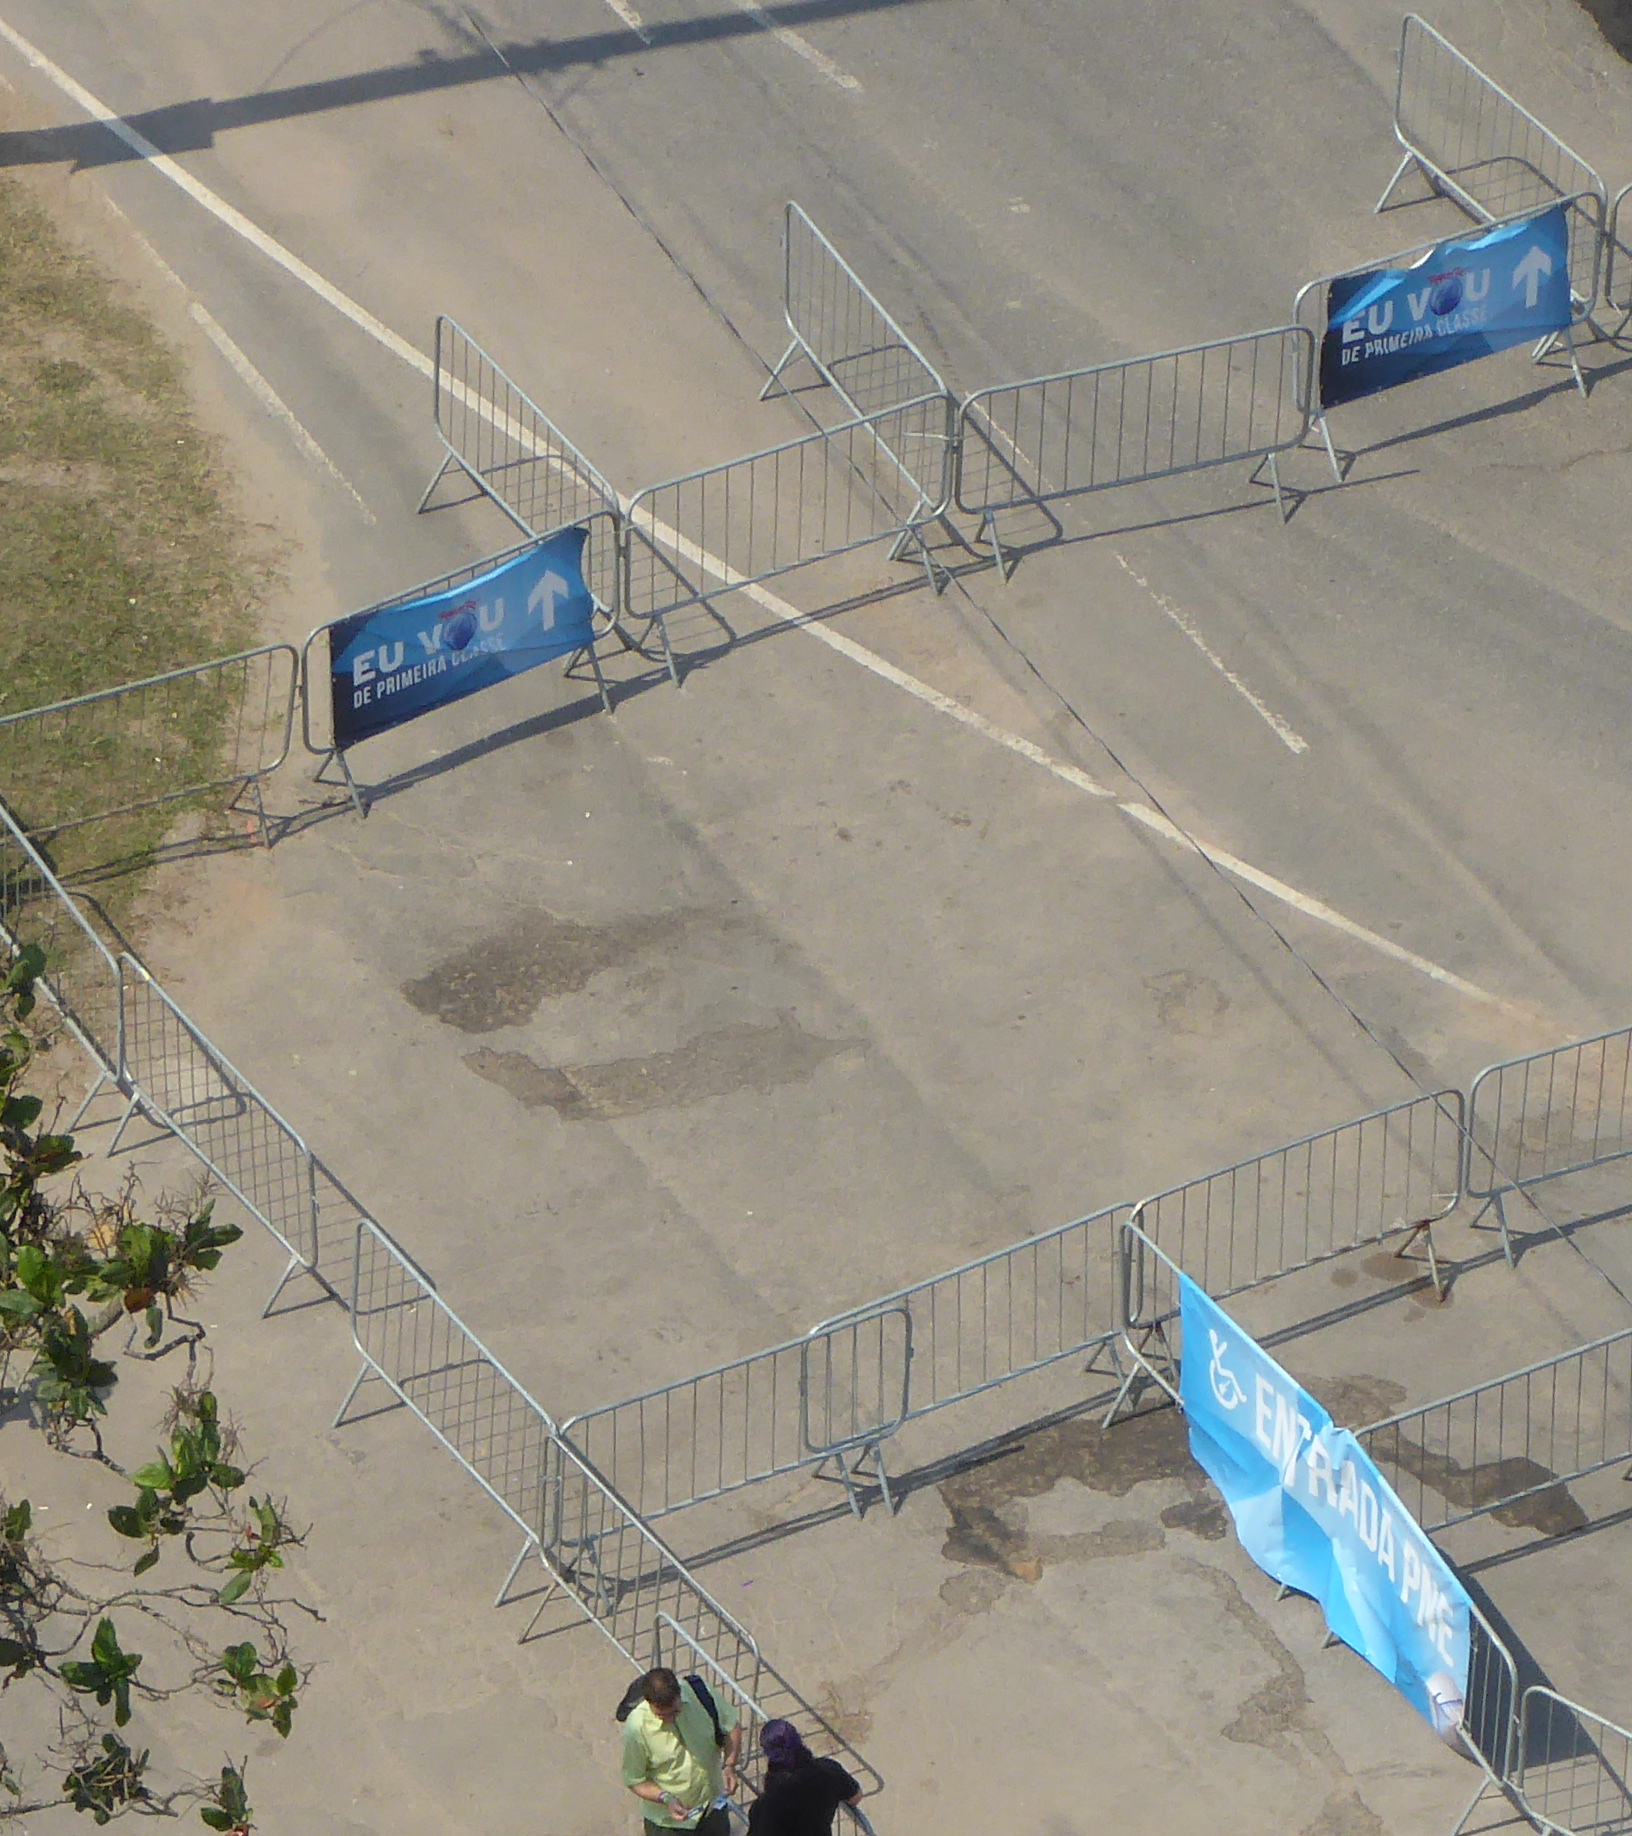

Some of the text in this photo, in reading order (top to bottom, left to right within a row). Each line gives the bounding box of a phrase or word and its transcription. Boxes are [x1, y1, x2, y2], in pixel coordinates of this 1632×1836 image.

[1342, 300, 1393, 344] EU
[1342, 304, 1488, 366] DE PRIMEIRA CLASSE
[353, 641, 404, 687] EU
[353, 632, 507, 709] DE PRIMEIRA CLASSE
[1254, 1372, 1454, 1668] ENTRADA PNE
